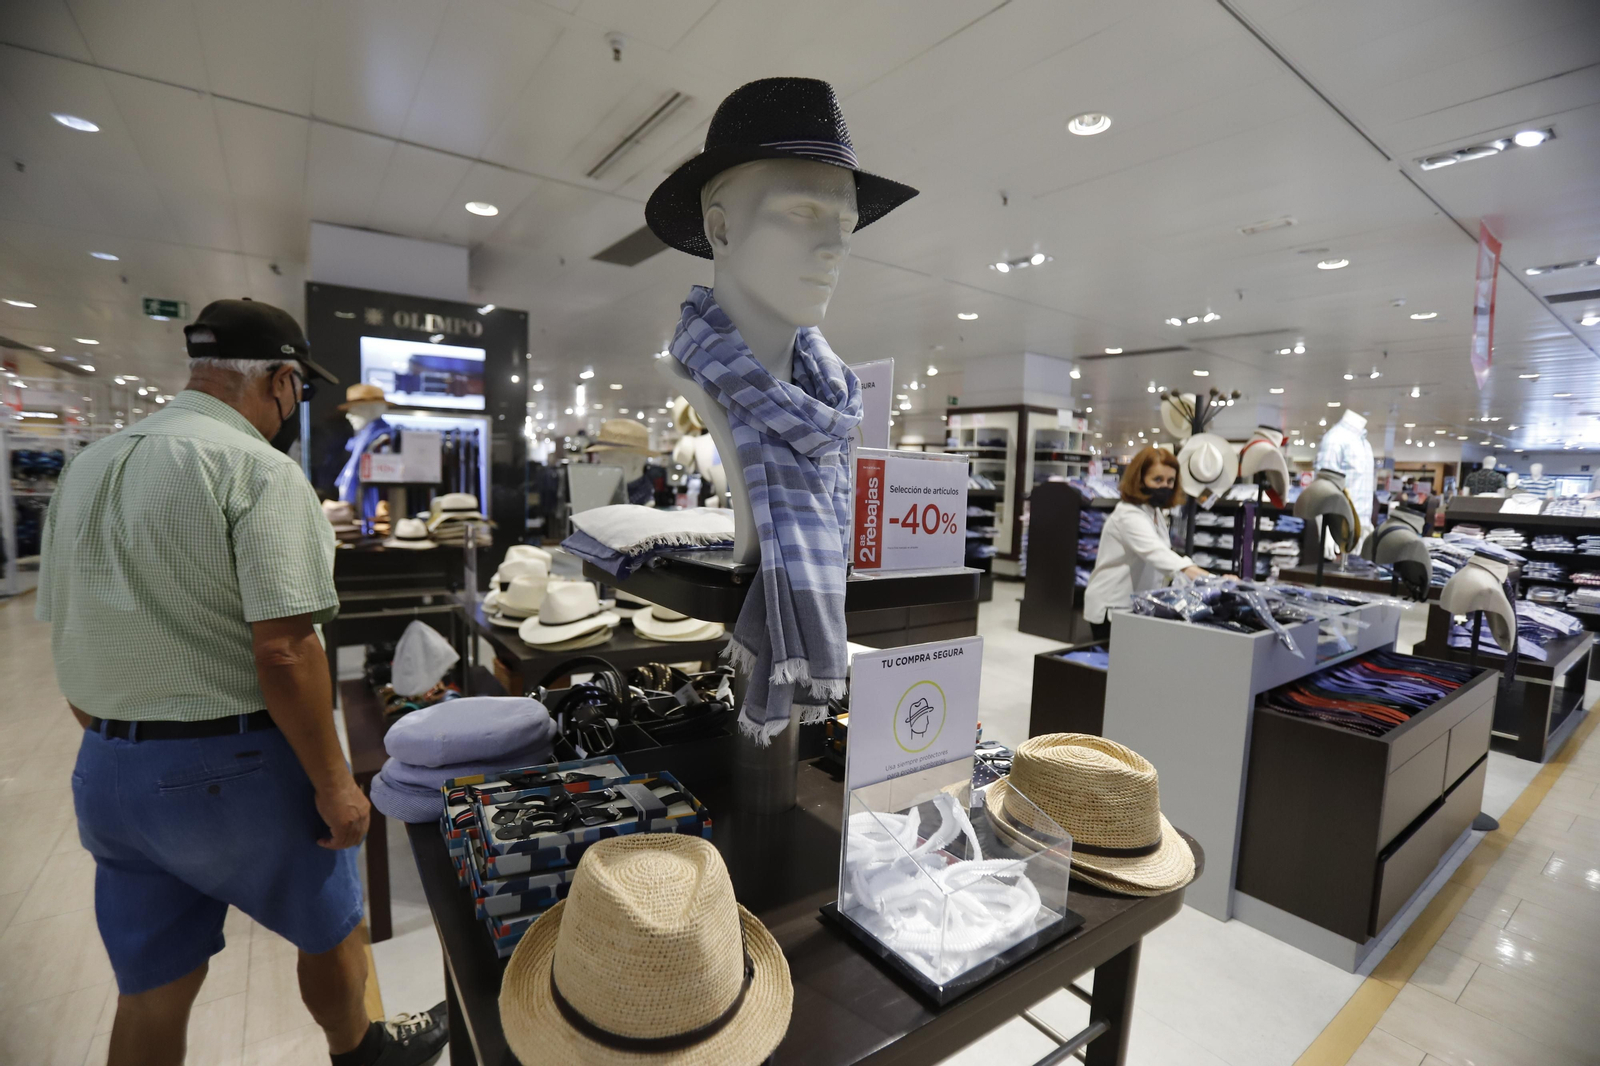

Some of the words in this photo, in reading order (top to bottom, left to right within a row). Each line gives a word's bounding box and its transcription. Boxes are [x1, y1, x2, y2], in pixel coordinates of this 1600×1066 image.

[393, 310, 484, 337] OLIMPO
[889, 485, 922, 494] Selección
[923, 486, 932, 495] de
[932, 487, 959, 496] artículos
[864, 477, 880, 546] rebajas
[889, 503, 958, 535] -40%
[882, 659, 893, 669] TU
[895, 653, 931, 667] COMPRA
[933, 647, 964, 660] SEGURA
[885, 764, 896, 772] Usa
[897, 757, 919, 769] siempre
[919, 749, 949, 763] protectores
[886, 770, 900, 780] para
